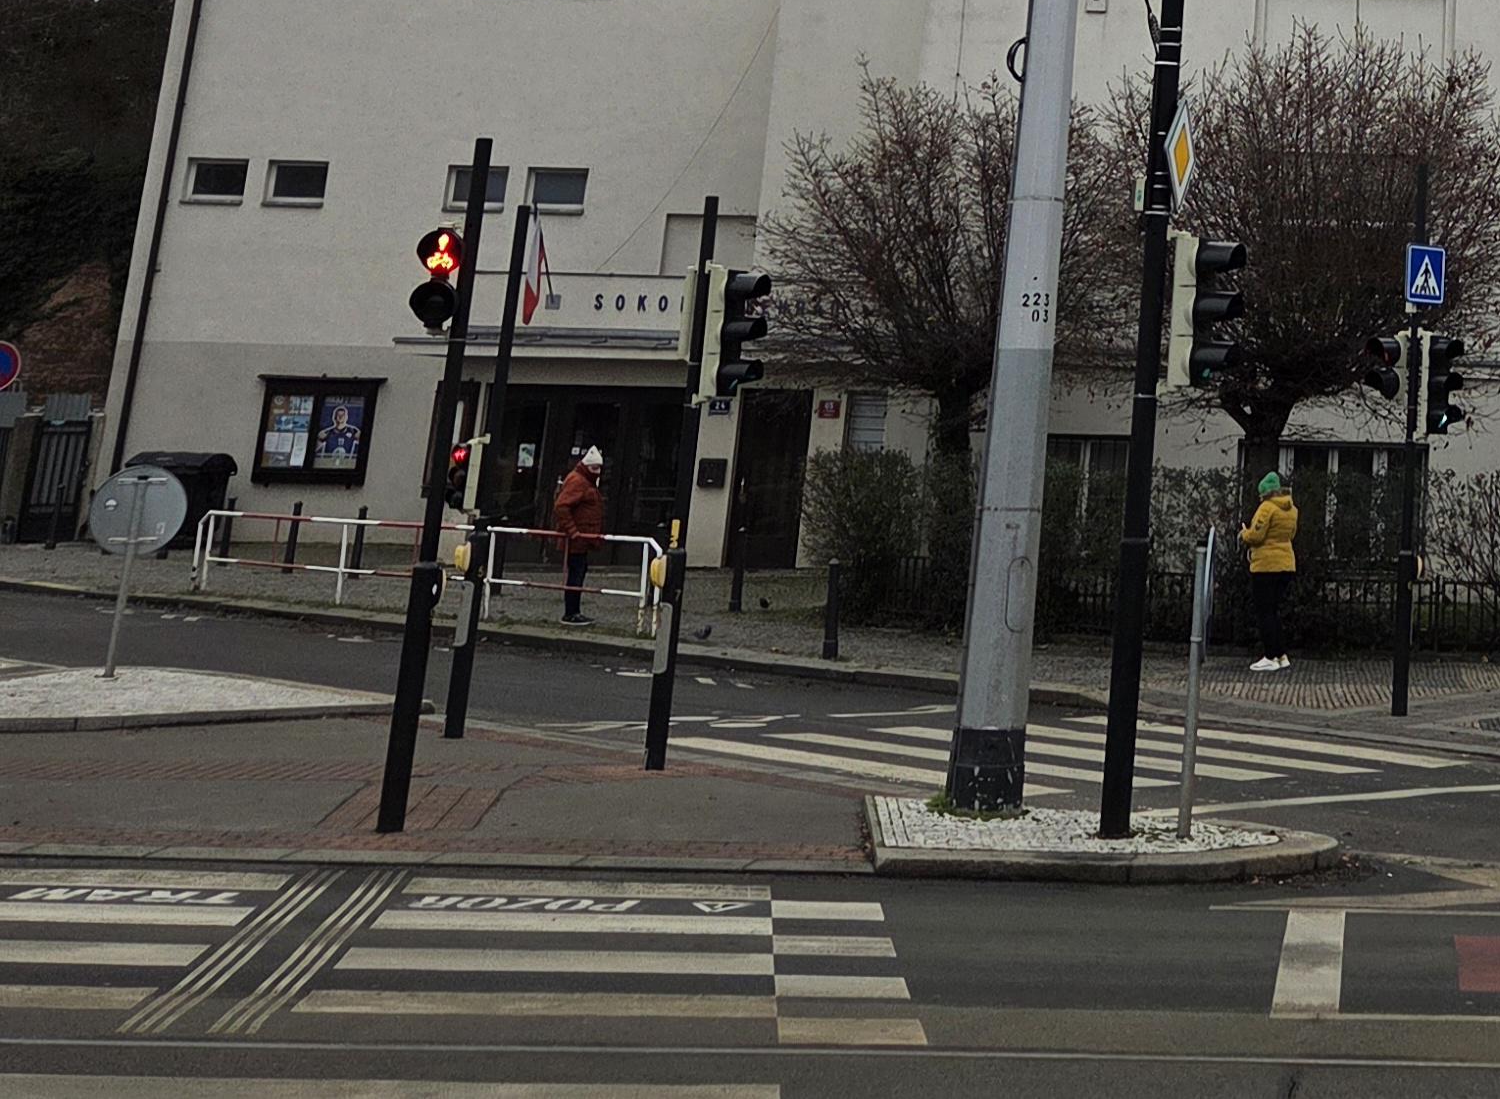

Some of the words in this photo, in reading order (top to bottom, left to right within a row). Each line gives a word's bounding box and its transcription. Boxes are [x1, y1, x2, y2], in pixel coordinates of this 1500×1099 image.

[1022, 292, 1050, 307] 223
[1031, 309, 1049, 323] 03
[5, 886, 241, 905] TRAM
[408, 894, 642, 913] POZOR
